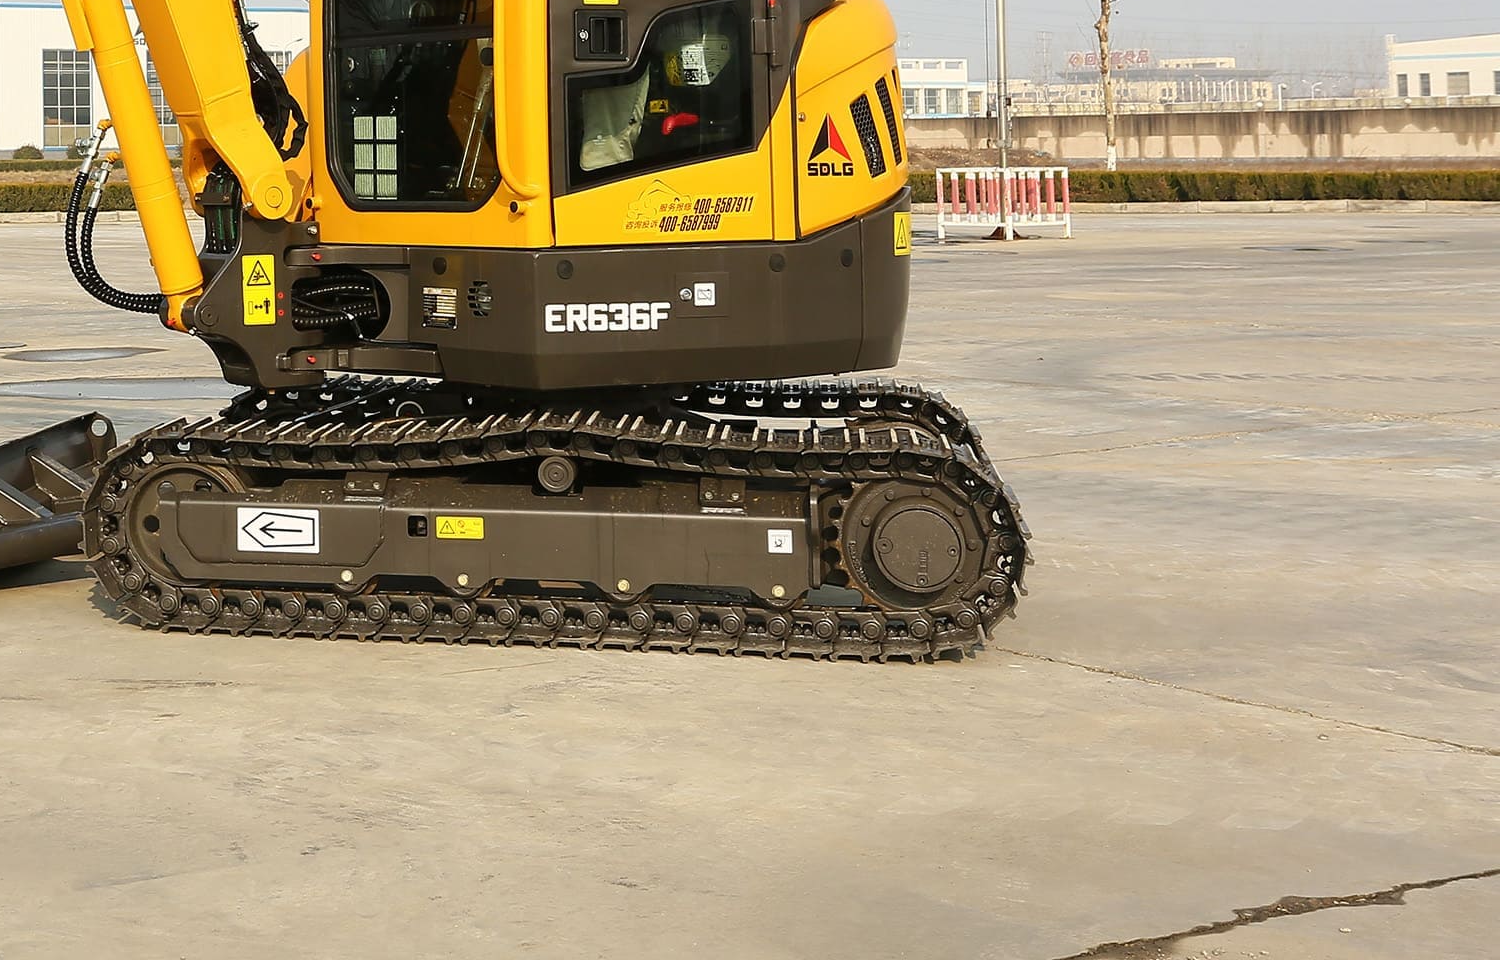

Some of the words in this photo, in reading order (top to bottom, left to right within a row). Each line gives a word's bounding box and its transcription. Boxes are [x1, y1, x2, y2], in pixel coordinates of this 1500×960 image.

[807, 163, 854, 176] SDLG
[693, 196, 754, 214] 400-6587911
[658, 214, 721, 232] 400-6587999
[545, 302, 671, 332] ER636F
